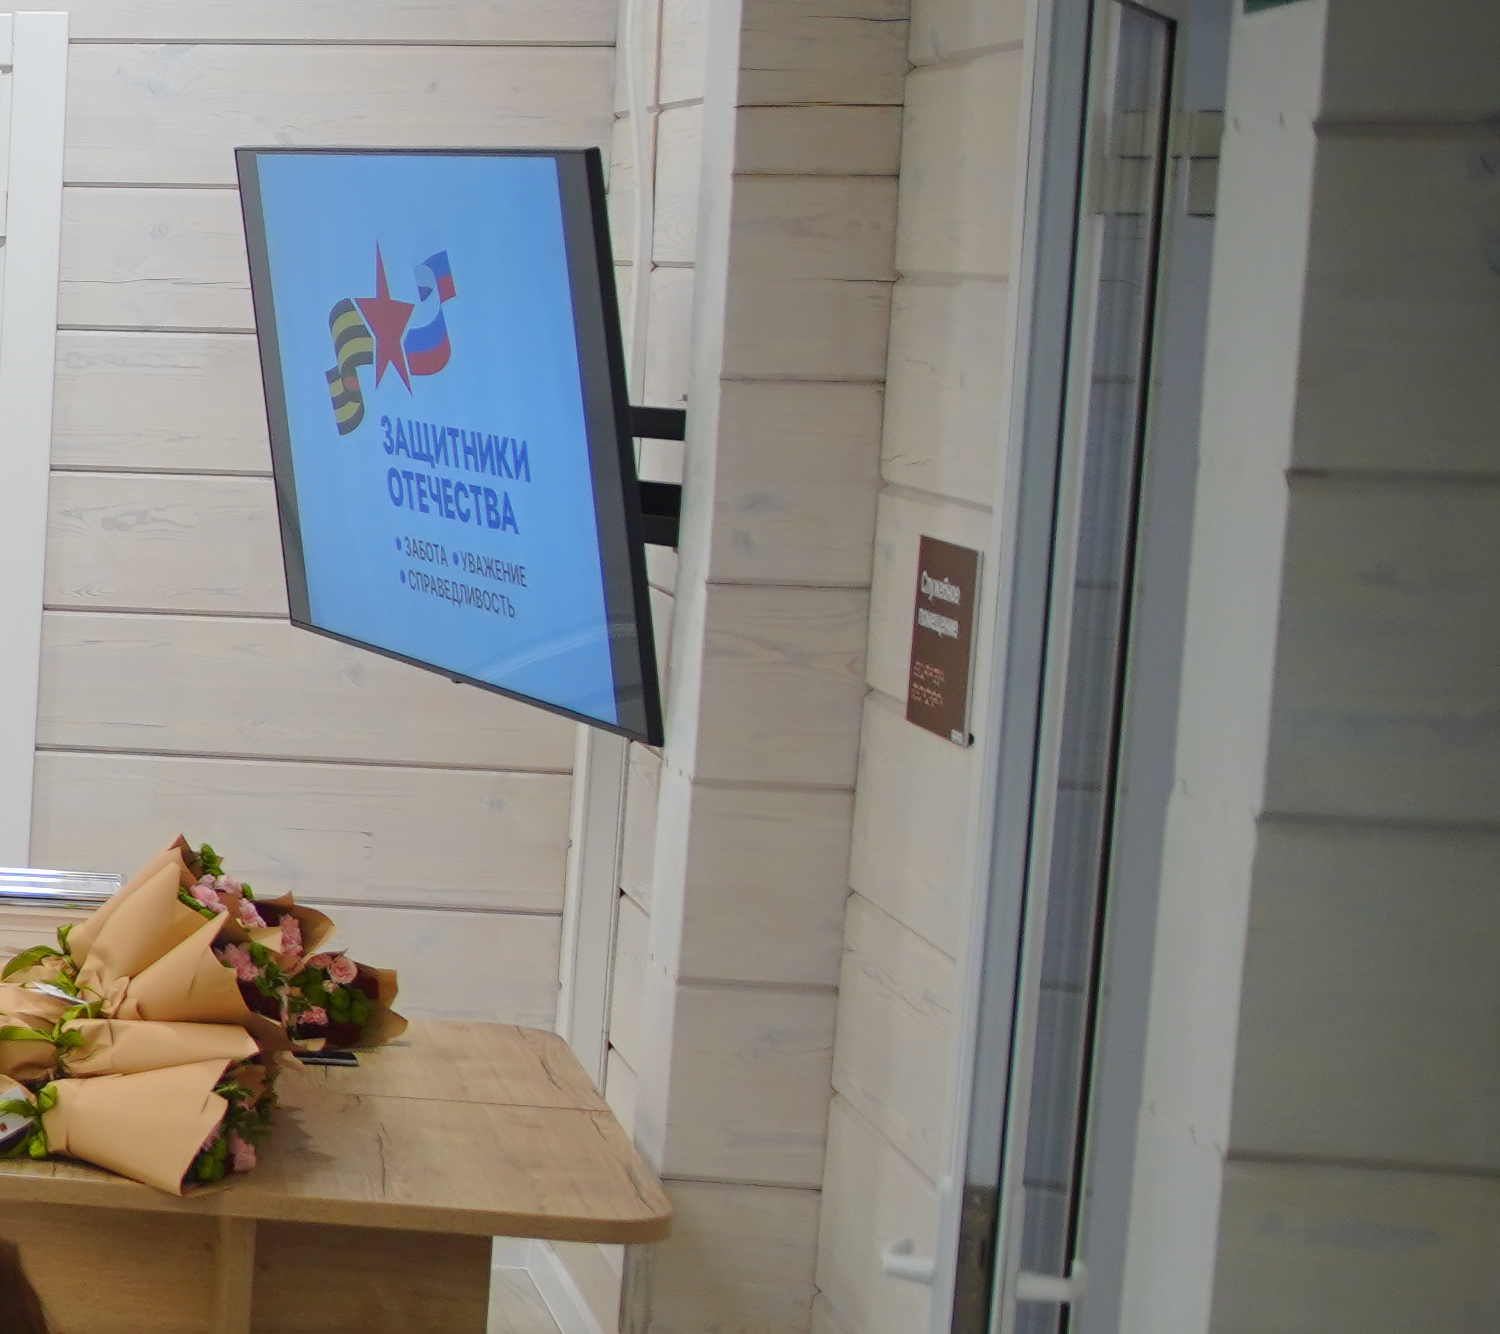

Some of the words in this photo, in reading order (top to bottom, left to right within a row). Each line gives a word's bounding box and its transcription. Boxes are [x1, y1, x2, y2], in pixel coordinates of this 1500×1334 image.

[380, 415, 531, 483] ЗАЩИТНИКИ
[387, 467, 520, 535] ОТЕЧЕСТВА
[404, 536, 449, 567] ЗАБОТА
[461, 551, 528, 588] УВАЖЕНИЕ
[408, 569, 516, 618] СПРАВЕДЛИВОСТЬ
